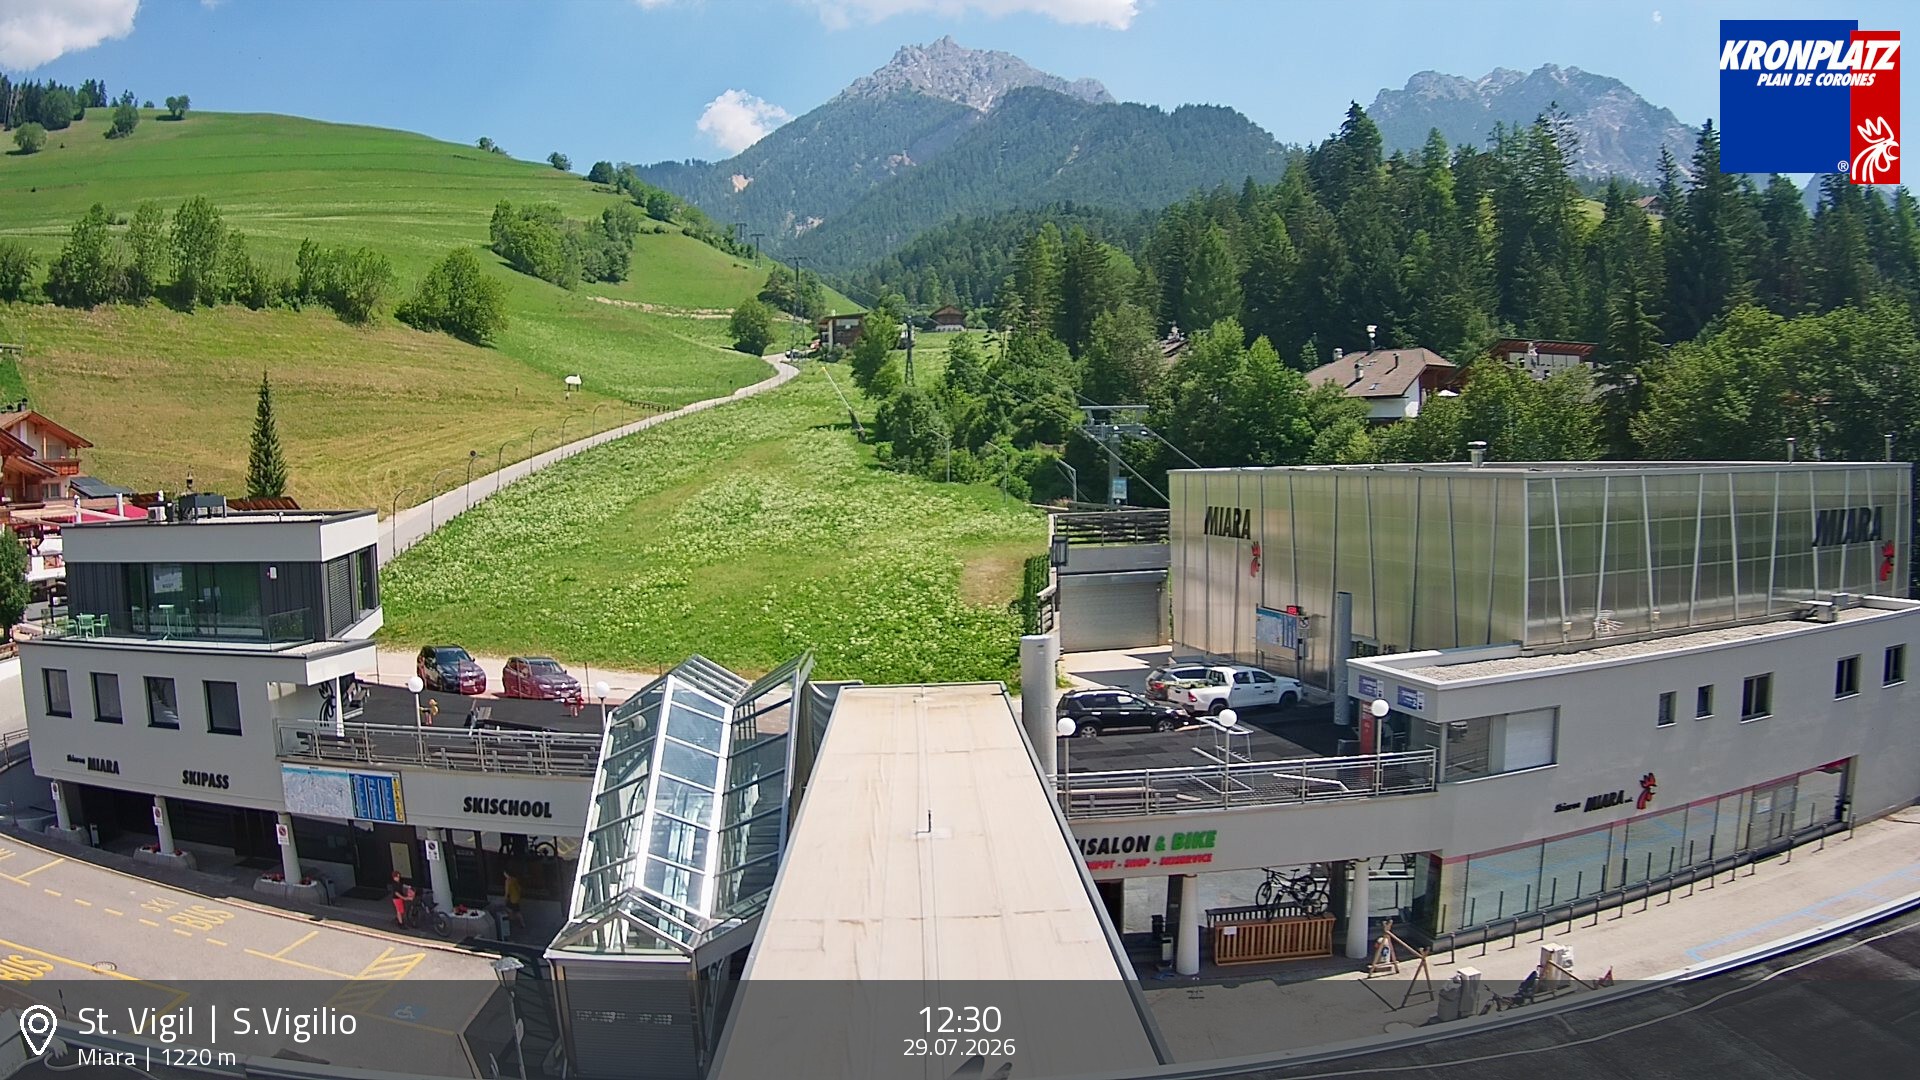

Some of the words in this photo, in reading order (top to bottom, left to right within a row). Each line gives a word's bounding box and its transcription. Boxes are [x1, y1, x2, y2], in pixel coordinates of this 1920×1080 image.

[1204, 506, 1251, 540] MIARA
[1812, 506, 1883, 547] MIARA
[87, 757, 120, 775] MIARA
[182, 770, 229, 789] SKIPASS
[463, 796, 553, 818] SKISCHOOL
[1583, 790, 1625, 812] MIARA
[1155, 836, 1166, 851] &
[1171, 830, 1217, 850] BIKE
[167, 905, 235, 931] BUS
